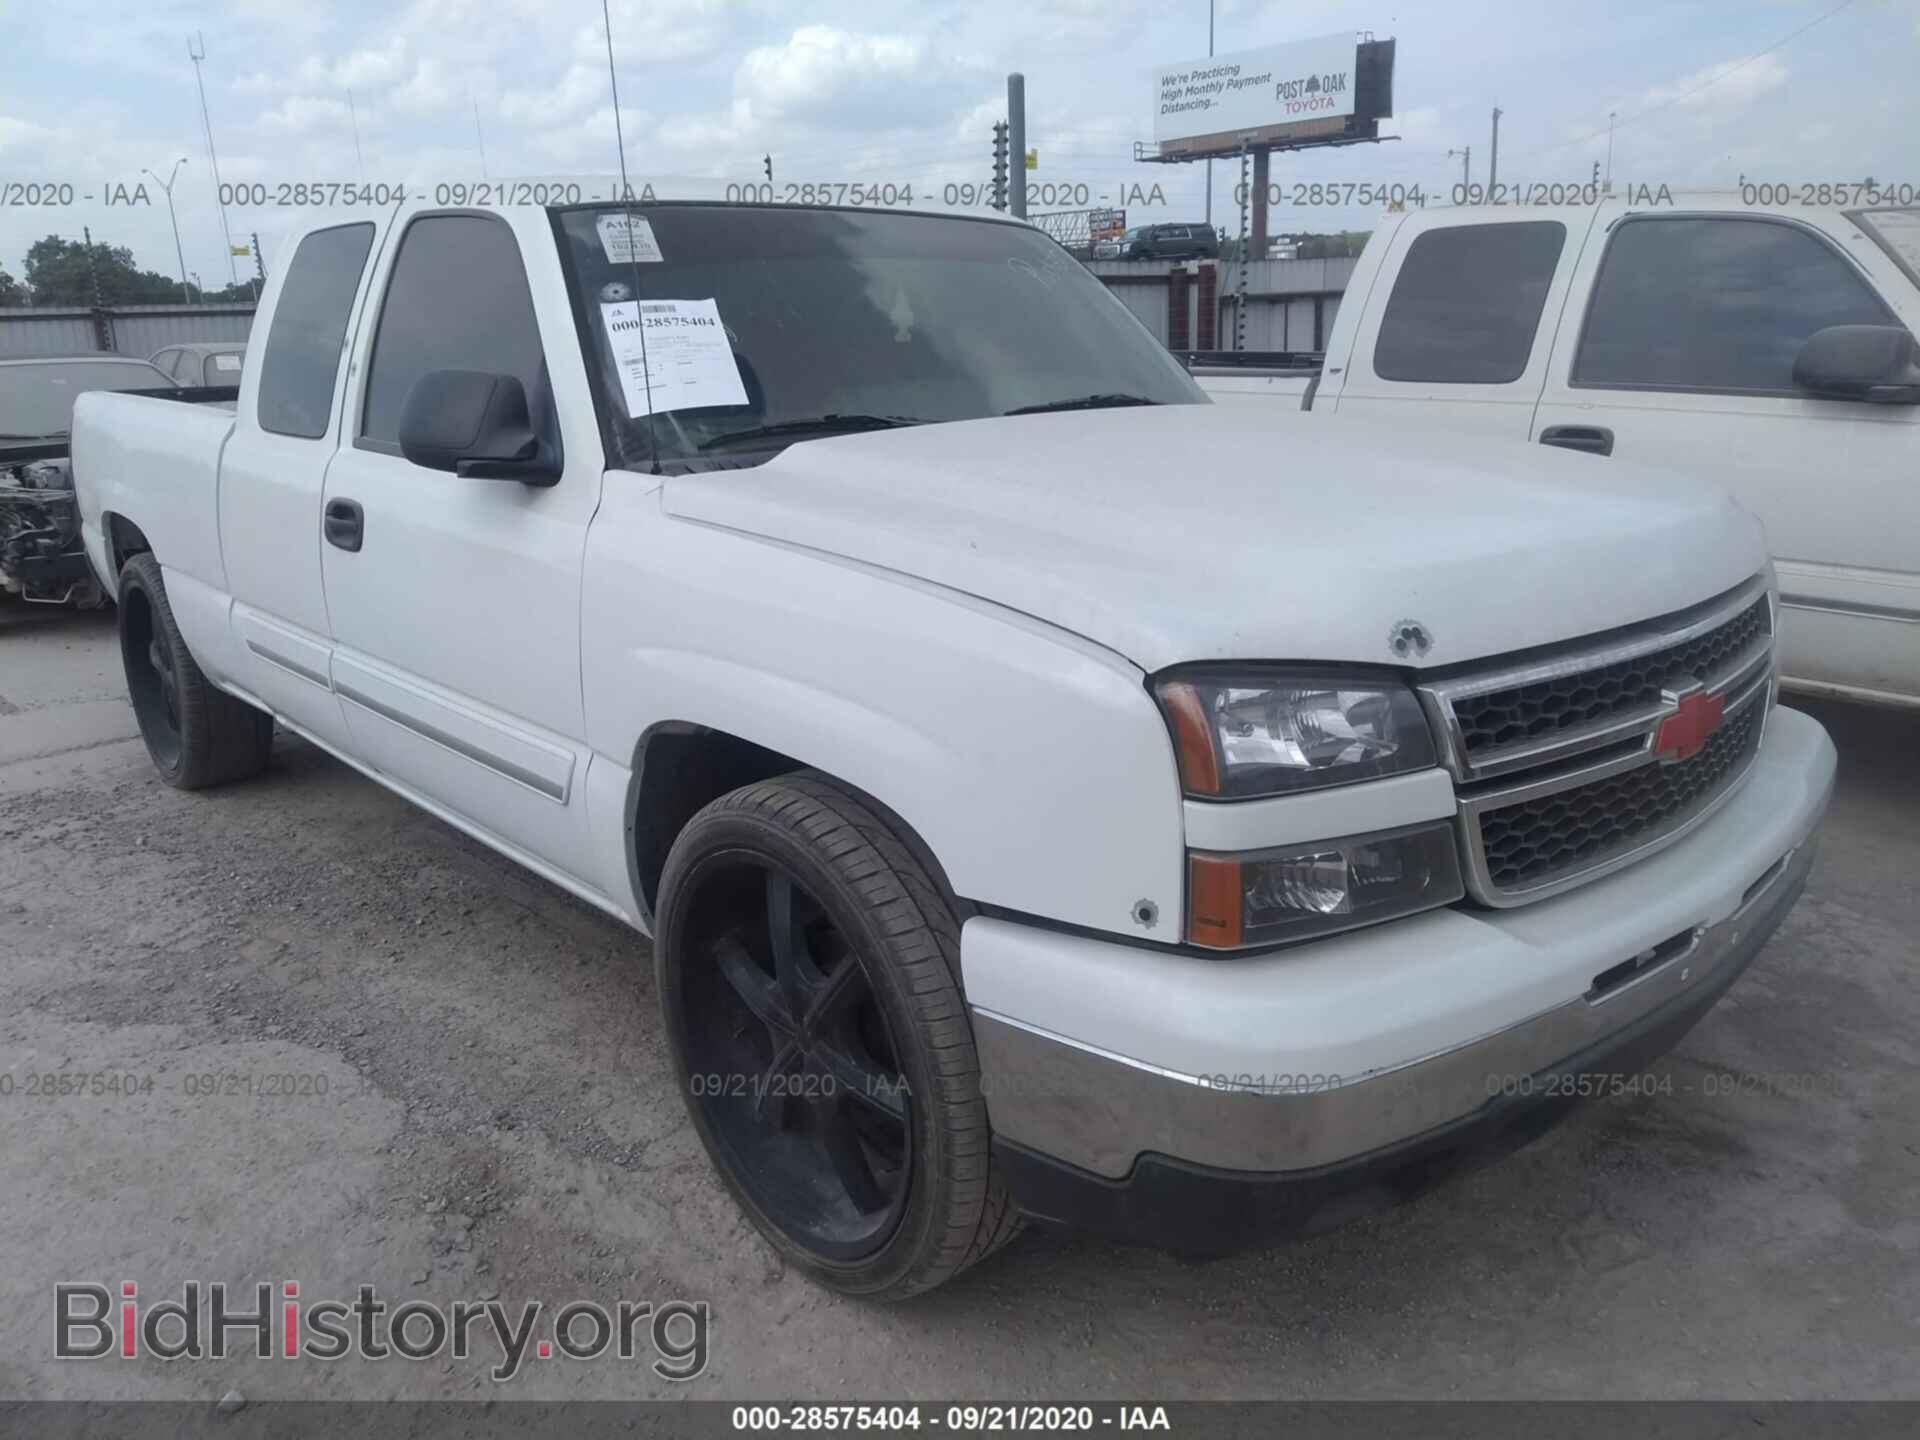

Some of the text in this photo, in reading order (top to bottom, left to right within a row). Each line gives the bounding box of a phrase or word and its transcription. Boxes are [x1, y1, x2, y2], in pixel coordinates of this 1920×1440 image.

[1161, 72, 1272, 102] High Monthly Payment
[1162, 64, 1240, 87] We're Practicing
[1276, 72, 1346, 100] POST OAK
[1286, 96, 1335, 114] TOYOTA
[611, 316, 716, 333] 000-28575404
